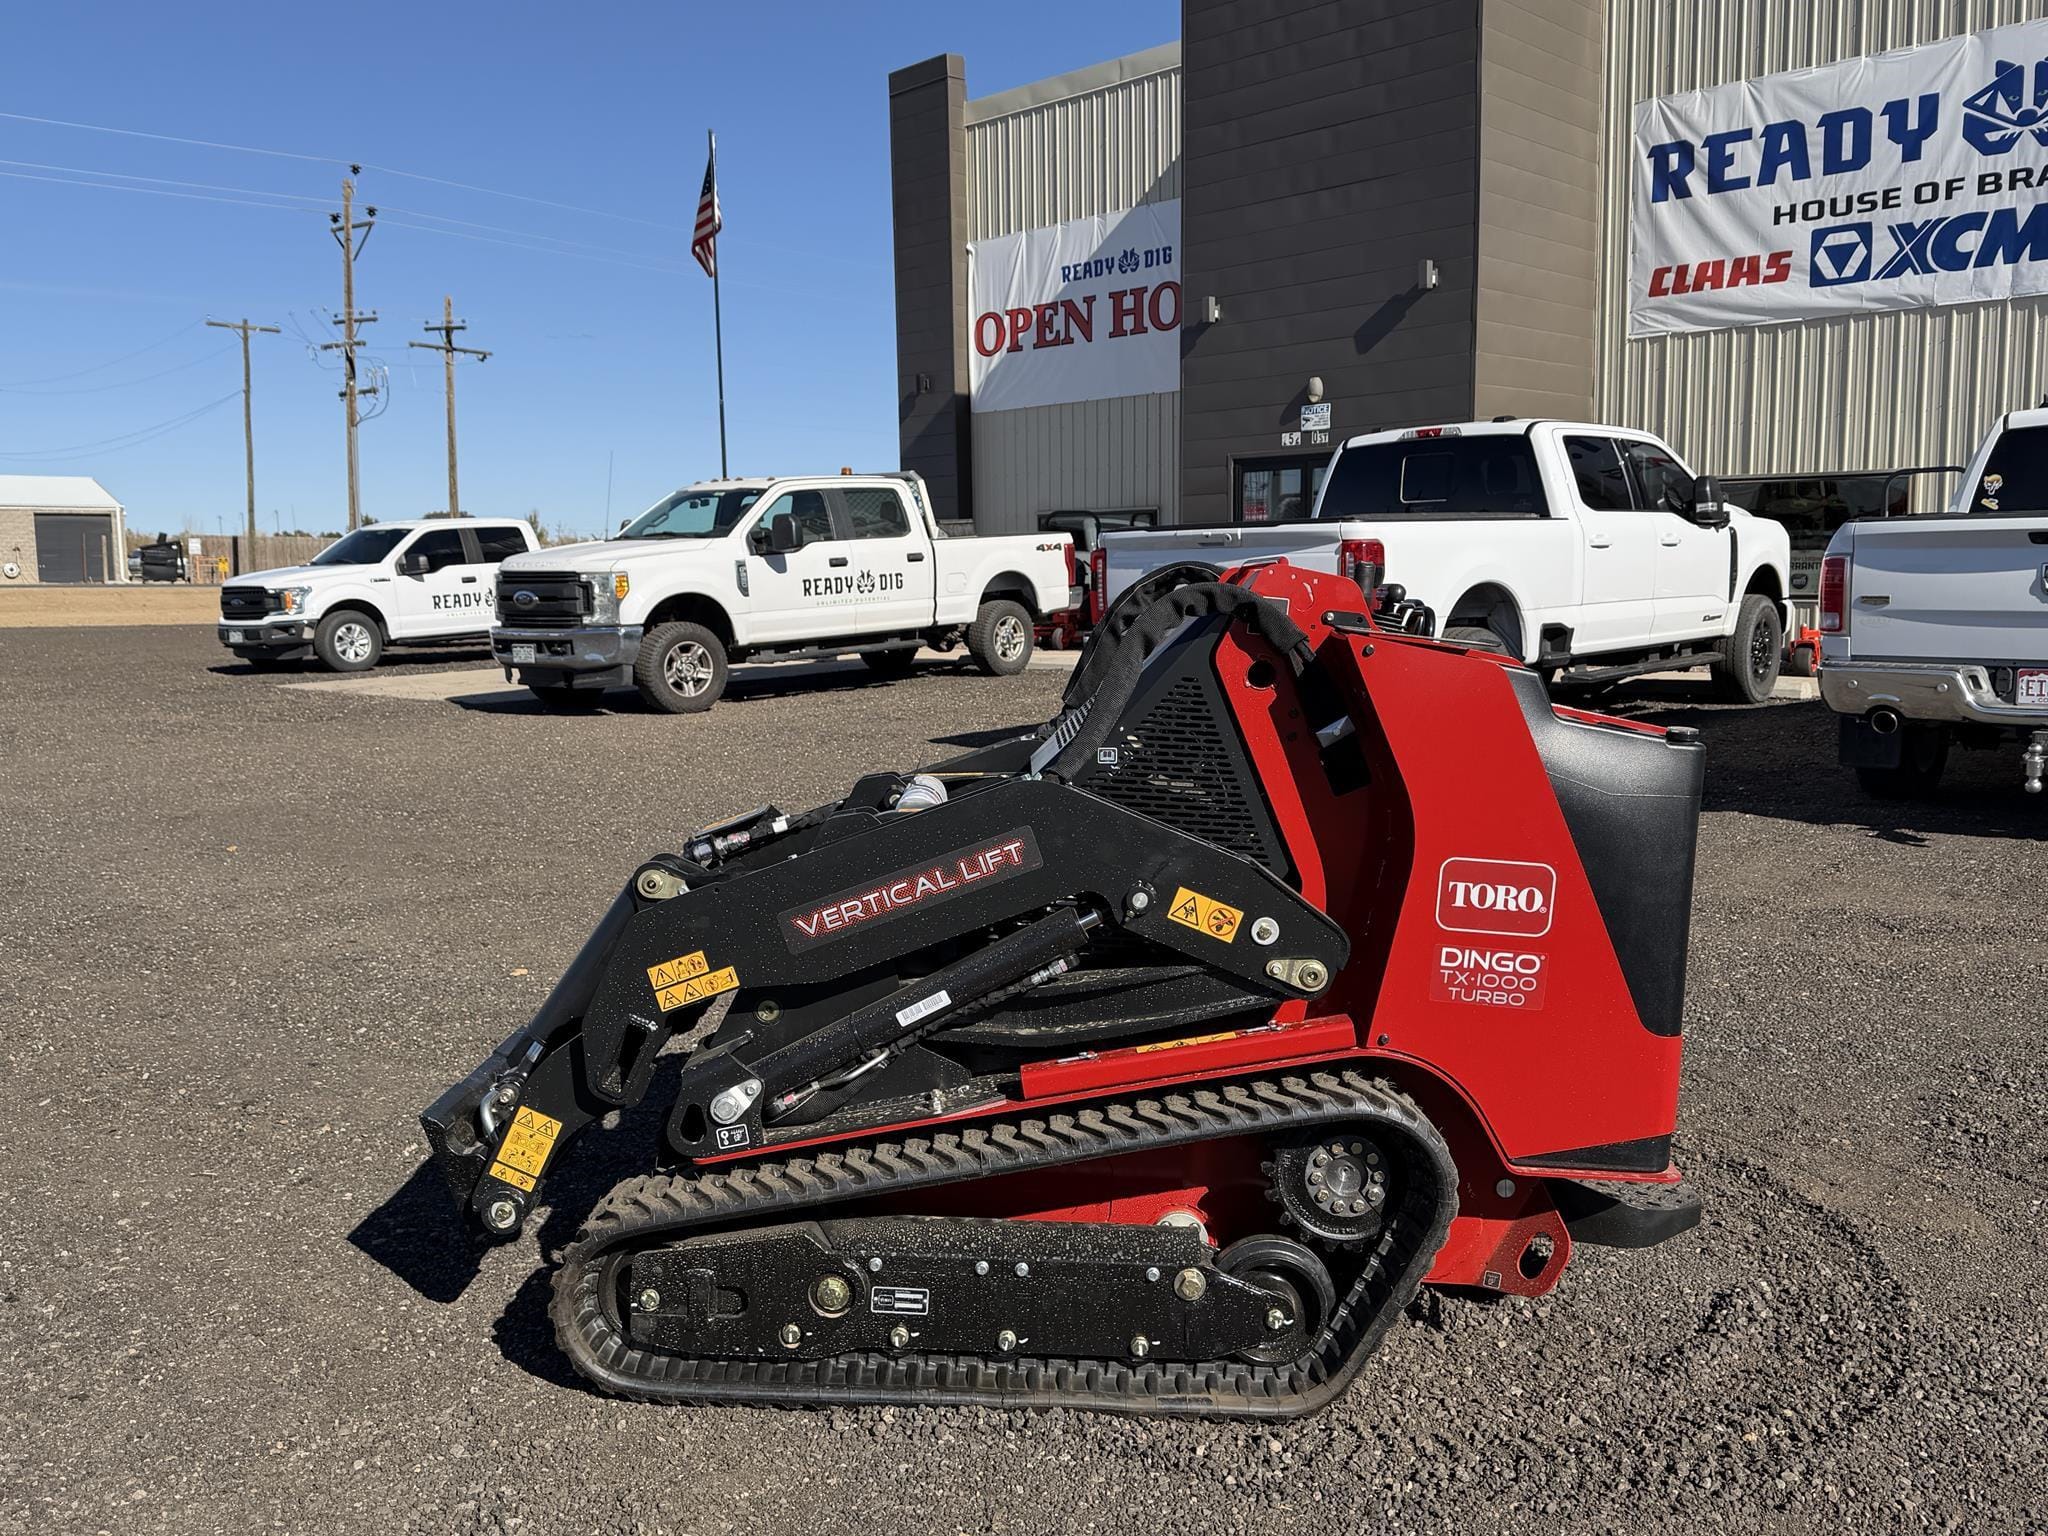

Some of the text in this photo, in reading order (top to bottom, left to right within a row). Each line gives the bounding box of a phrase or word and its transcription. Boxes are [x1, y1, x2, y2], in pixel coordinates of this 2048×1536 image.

[1647, 92, 1940, 203] READY
[1773, 187, 1902, 226] HOUSE
[1914, 181, 1966, 205] OF
[1061, 246, 1172, 283] READY DIG
[1648, 250, 1794, 298] CLAAS
[974, 281, 1180, 357] OPEN HO
[432, 592, 481, 610] READY
[802, 572, 904, 597] READY DIG
[794, 840, 1023, 937] VERTICAL LIFT
[1440, 947, 1541, 974] DINGO
[1448, 987, 1525, 1006] TURBO
